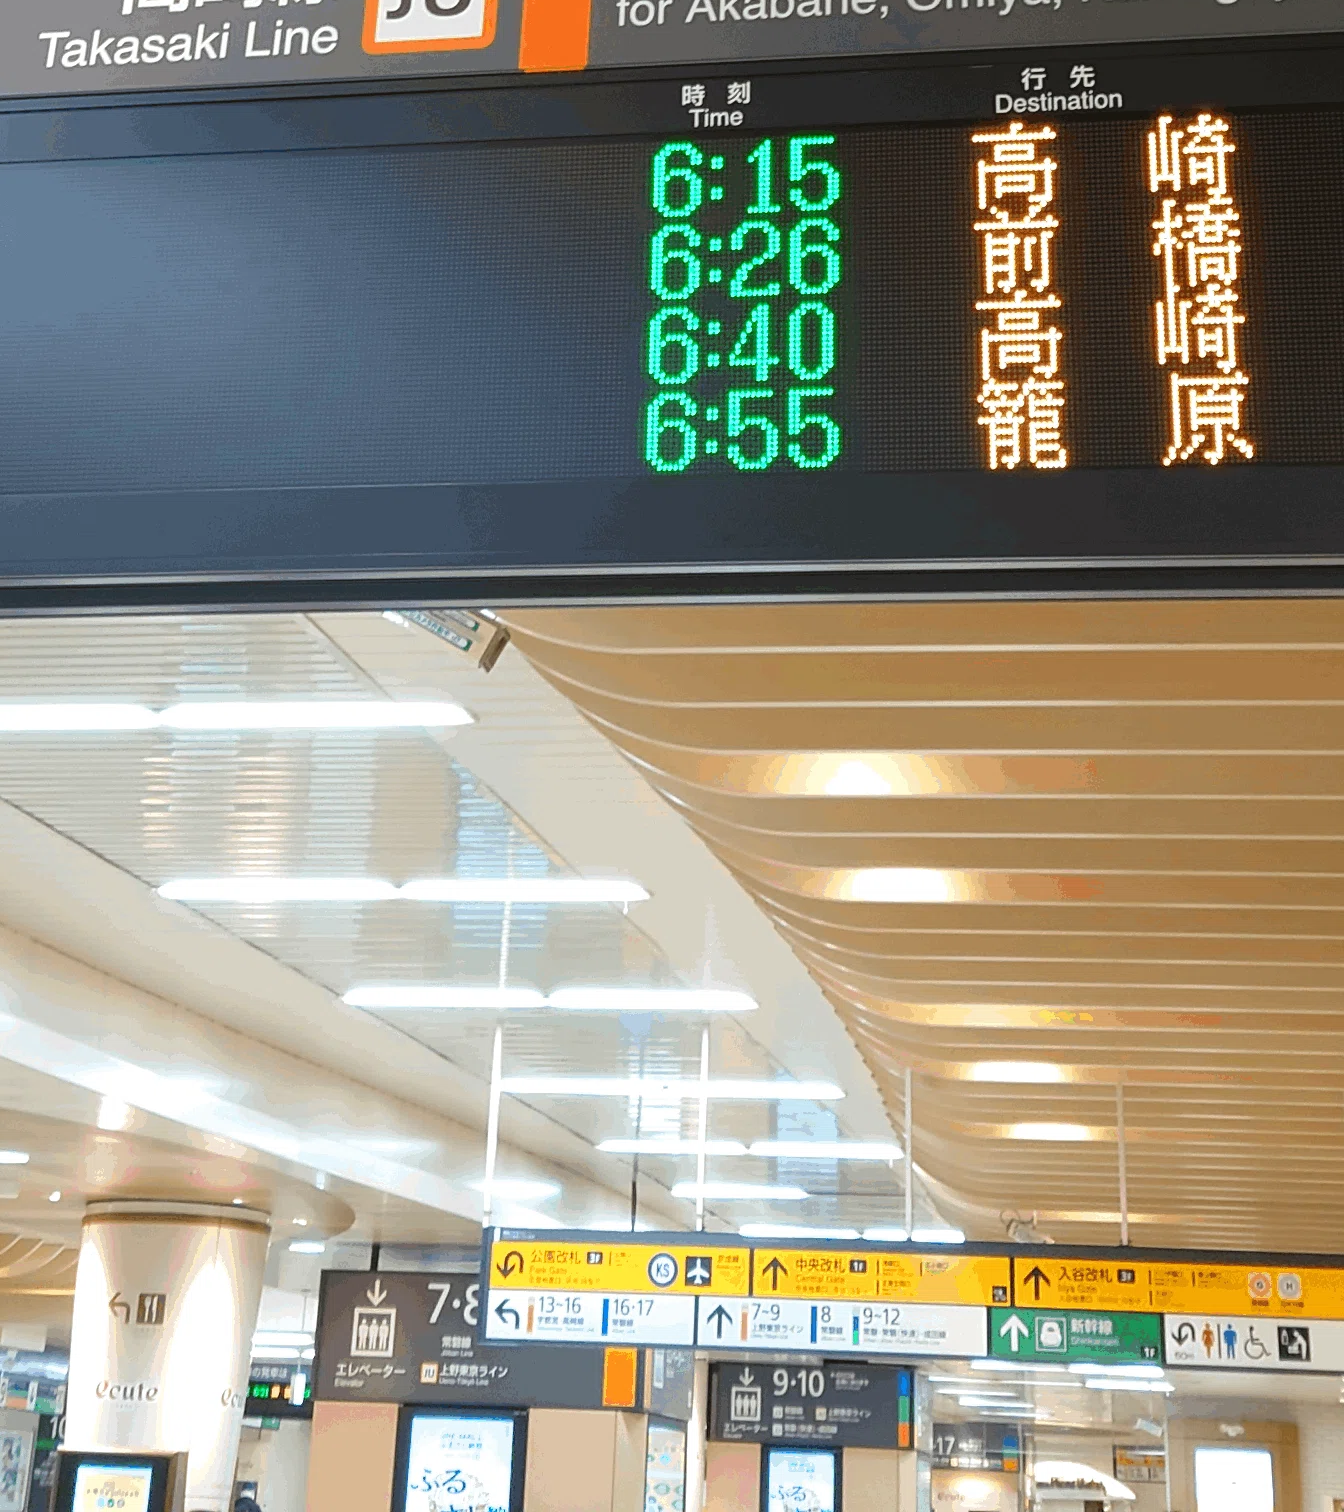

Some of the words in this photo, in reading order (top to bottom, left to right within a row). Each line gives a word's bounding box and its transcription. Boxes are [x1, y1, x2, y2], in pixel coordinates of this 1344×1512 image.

[38, 22, 231, 69] Takasaki
[244, 18, 339, 58] Line
[995, 89, 1124, 117] Destination
[689, 107, 744, 129] Time
[651, 135, 842, 219] 6:15
[649, 217, 842, 301] 6:26
[646, 300, 837, 385] 6:40
[644, 385, 842, 473] 6:55
[656, 1263, 670, 1278] KS
[795, 1256, 845, 1274] 中央改札
[1058, 1266, 1113, 1283] 入谷改札
[821, 1305, 831, 1323] 8
[1070, 1317, 1113, 1336] 新幹線
[336, 1362, 406, 1379] エレベーター
[439, 1364, 508, 1379] 上野東京ライン
[96, 1380, 159, 1402] ecute
